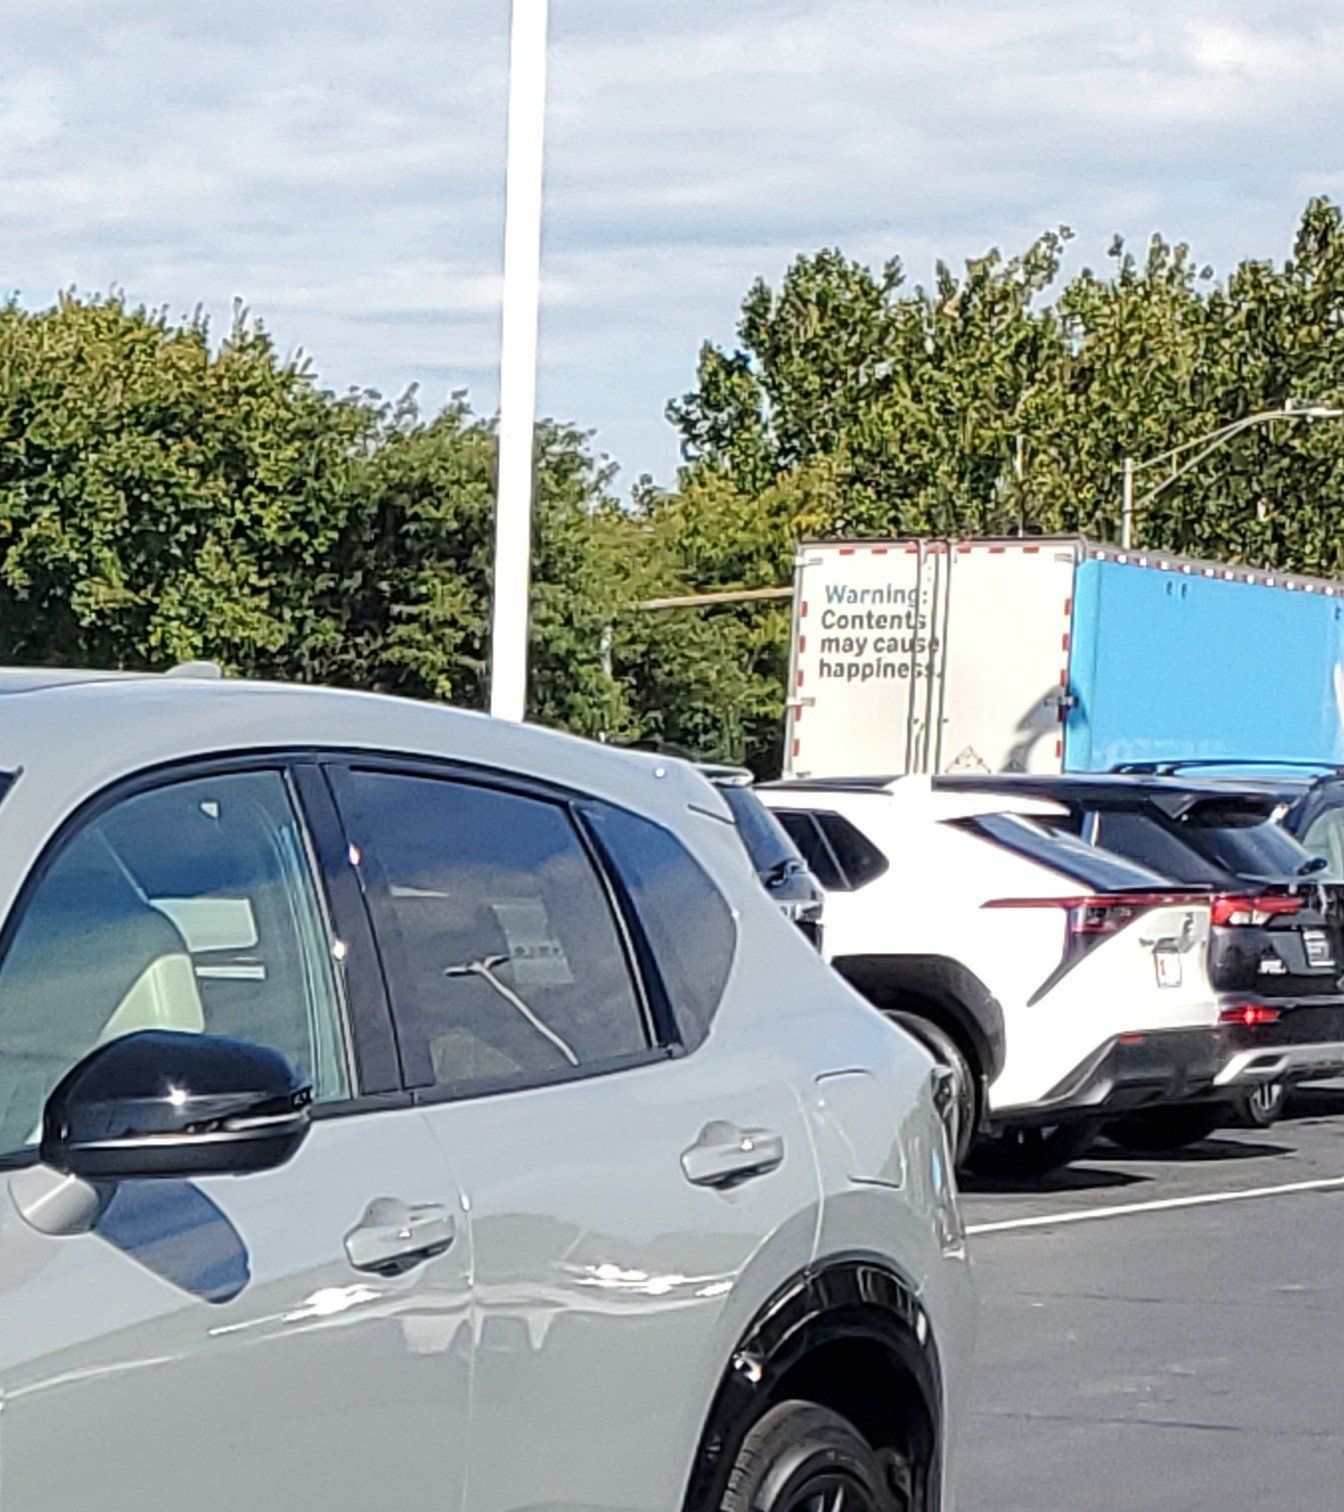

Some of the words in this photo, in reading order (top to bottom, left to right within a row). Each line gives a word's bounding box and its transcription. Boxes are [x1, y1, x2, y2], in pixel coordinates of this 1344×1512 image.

[825, 583, 928, 607] Warning:
[821, 609, 926, 629] Contents
[820, 637, 868, 656] may
[873, 637, 940, 653] cause
